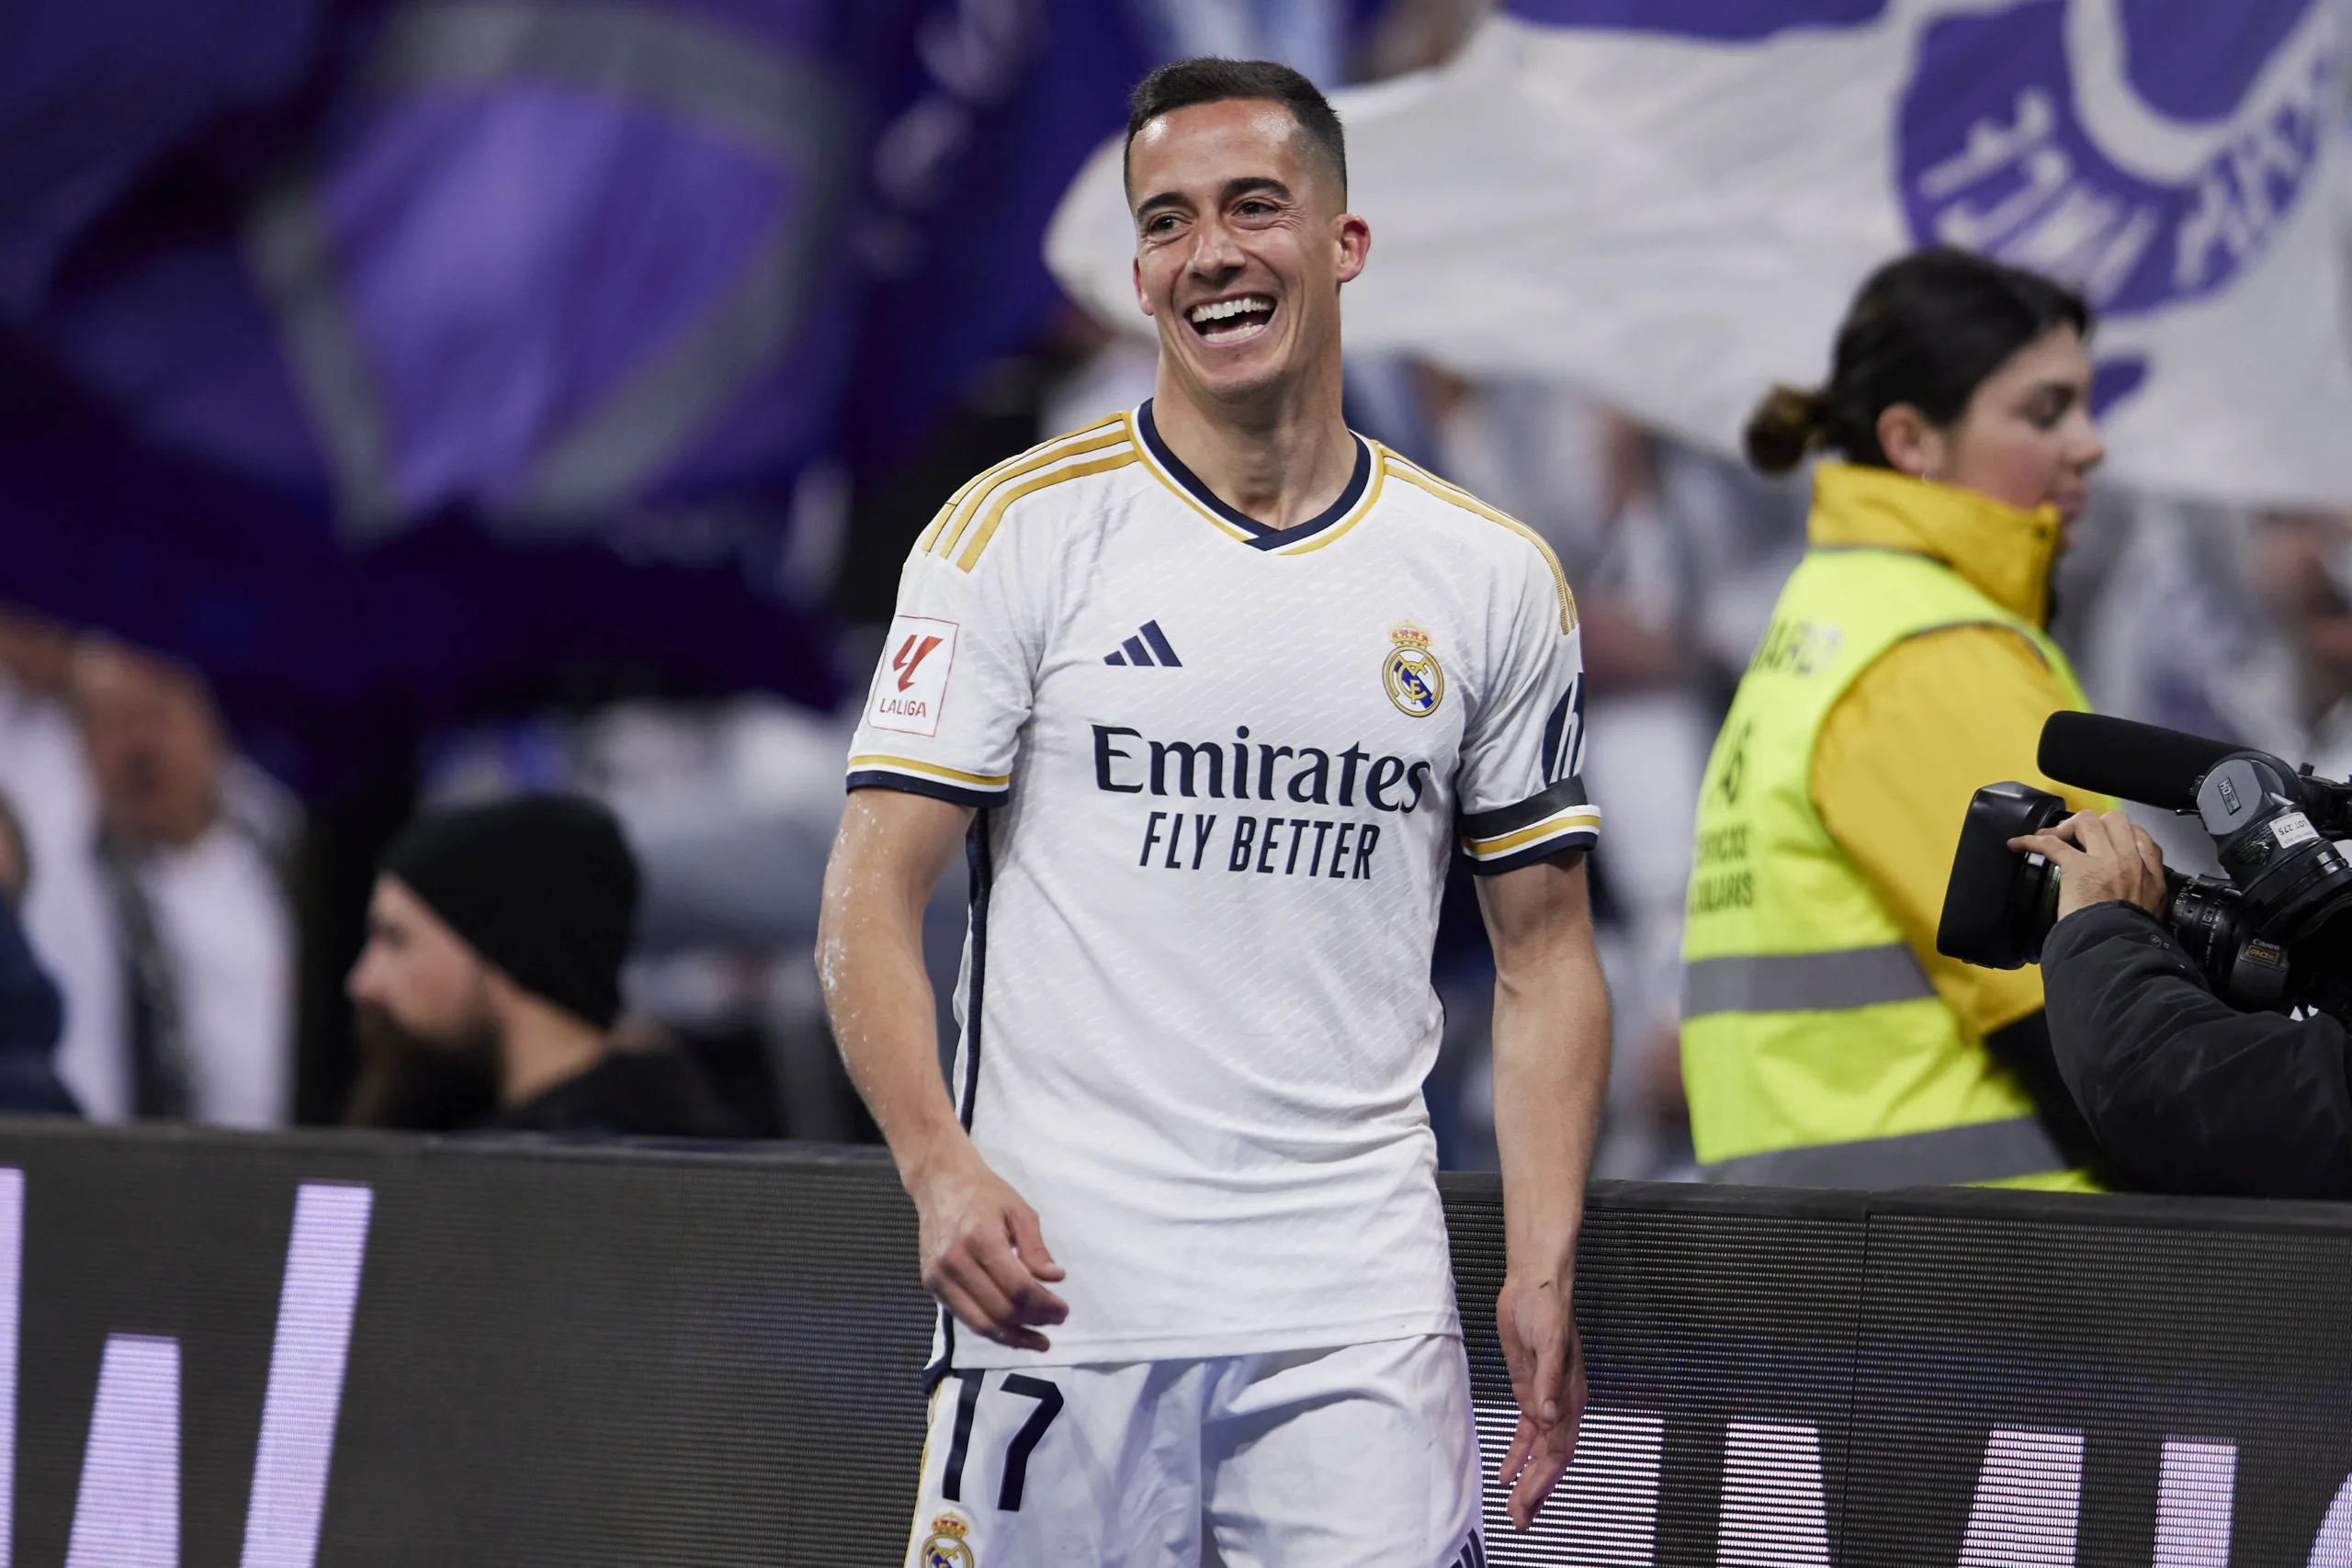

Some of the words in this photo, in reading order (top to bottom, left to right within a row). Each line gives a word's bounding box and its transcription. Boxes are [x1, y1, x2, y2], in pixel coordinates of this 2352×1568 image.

[879, 698, 927, 717] LALIGA
[1091, 725, 1430, 814] Emirates
[2278, 824, 2294, 836] 275
[2293, 819, 2309, 829] LOT
[1139, 811, 1216, 870] FLY
[1228, 816, 1380, 880] BETTER
[2252, 939, 2280, 951] Canon
[943, 1368, 1064, 1512] 17
